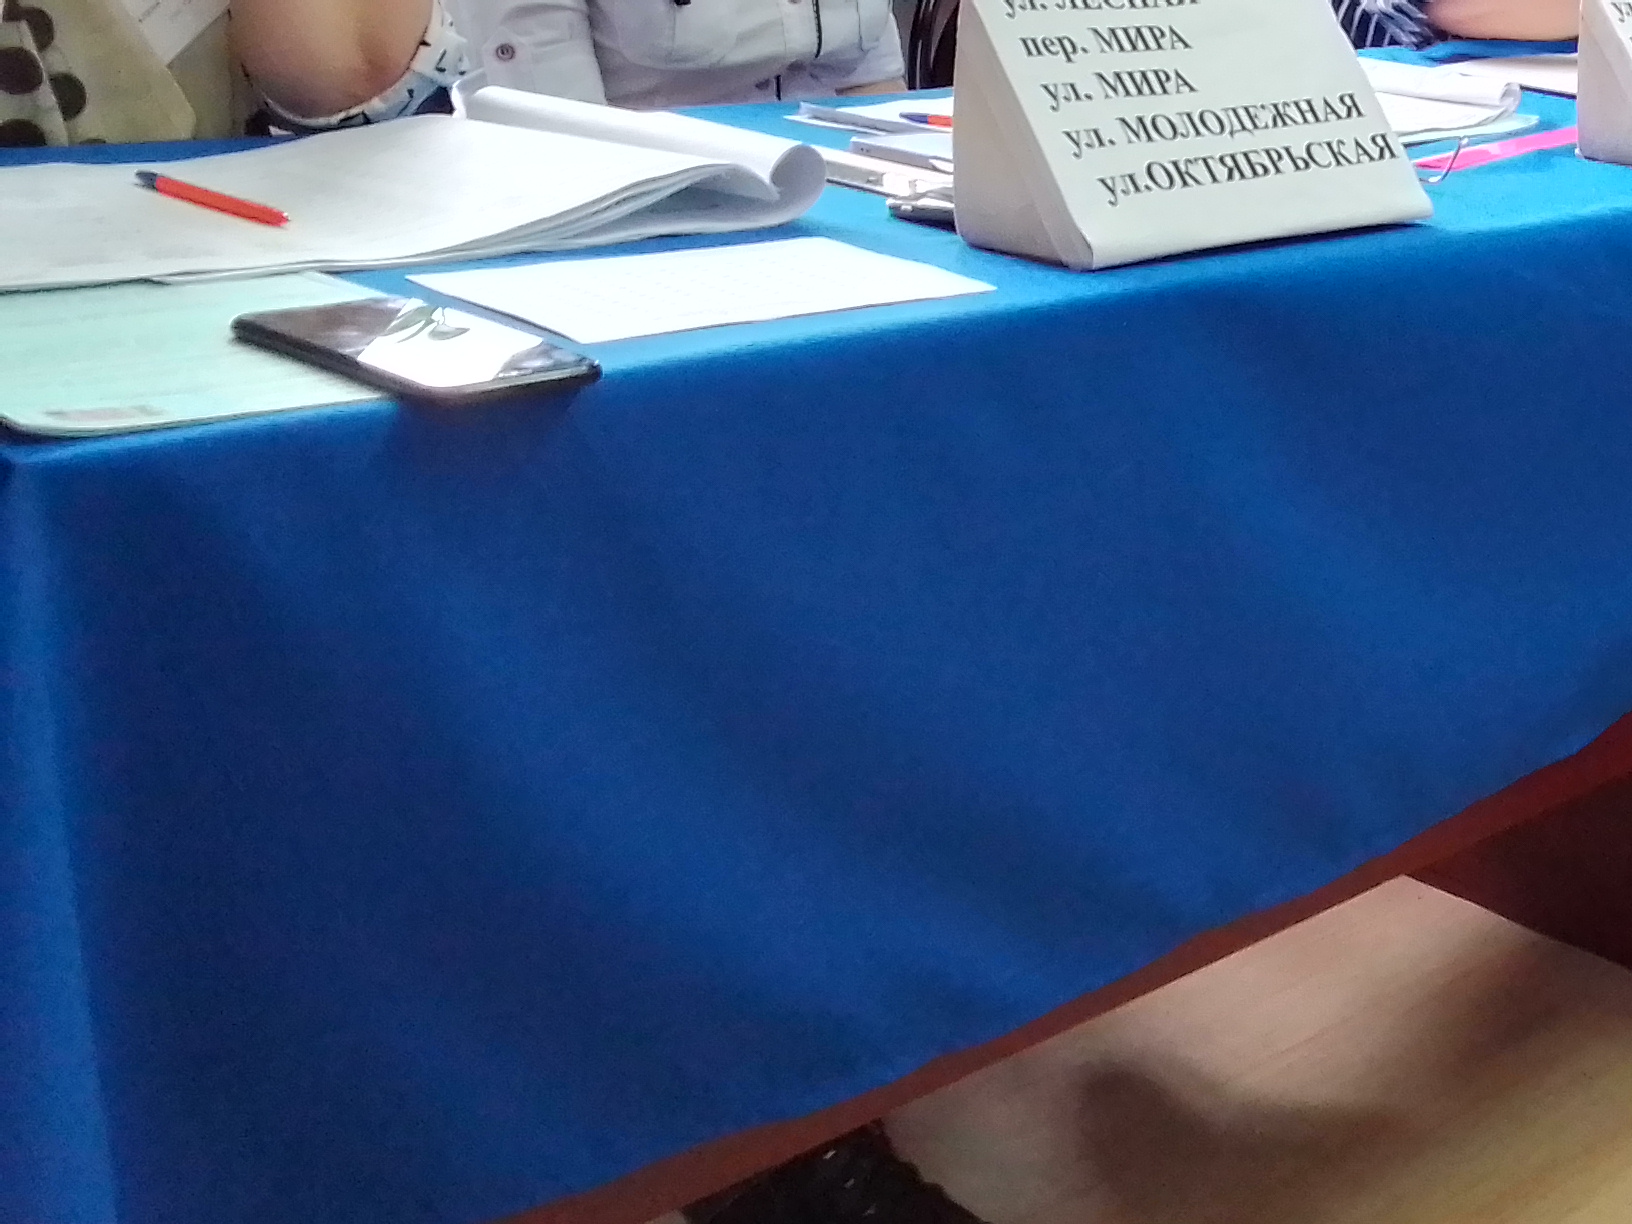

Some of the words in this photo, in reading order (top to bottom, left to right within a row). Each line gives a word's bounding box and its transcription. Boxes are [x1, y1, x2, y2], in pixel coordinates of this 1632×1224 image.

[1021, 33, 1088, 64] пер.
[1092, 23, 1193, 56] МИРА
[1041, 82, 1093, 113] ул.
[1099, 69, 1200, 99] МИРА
[1062, 128, 1116, 159] ул.
[1118, 92, 1366, 144] МОЛОДЕЖНАЯ
